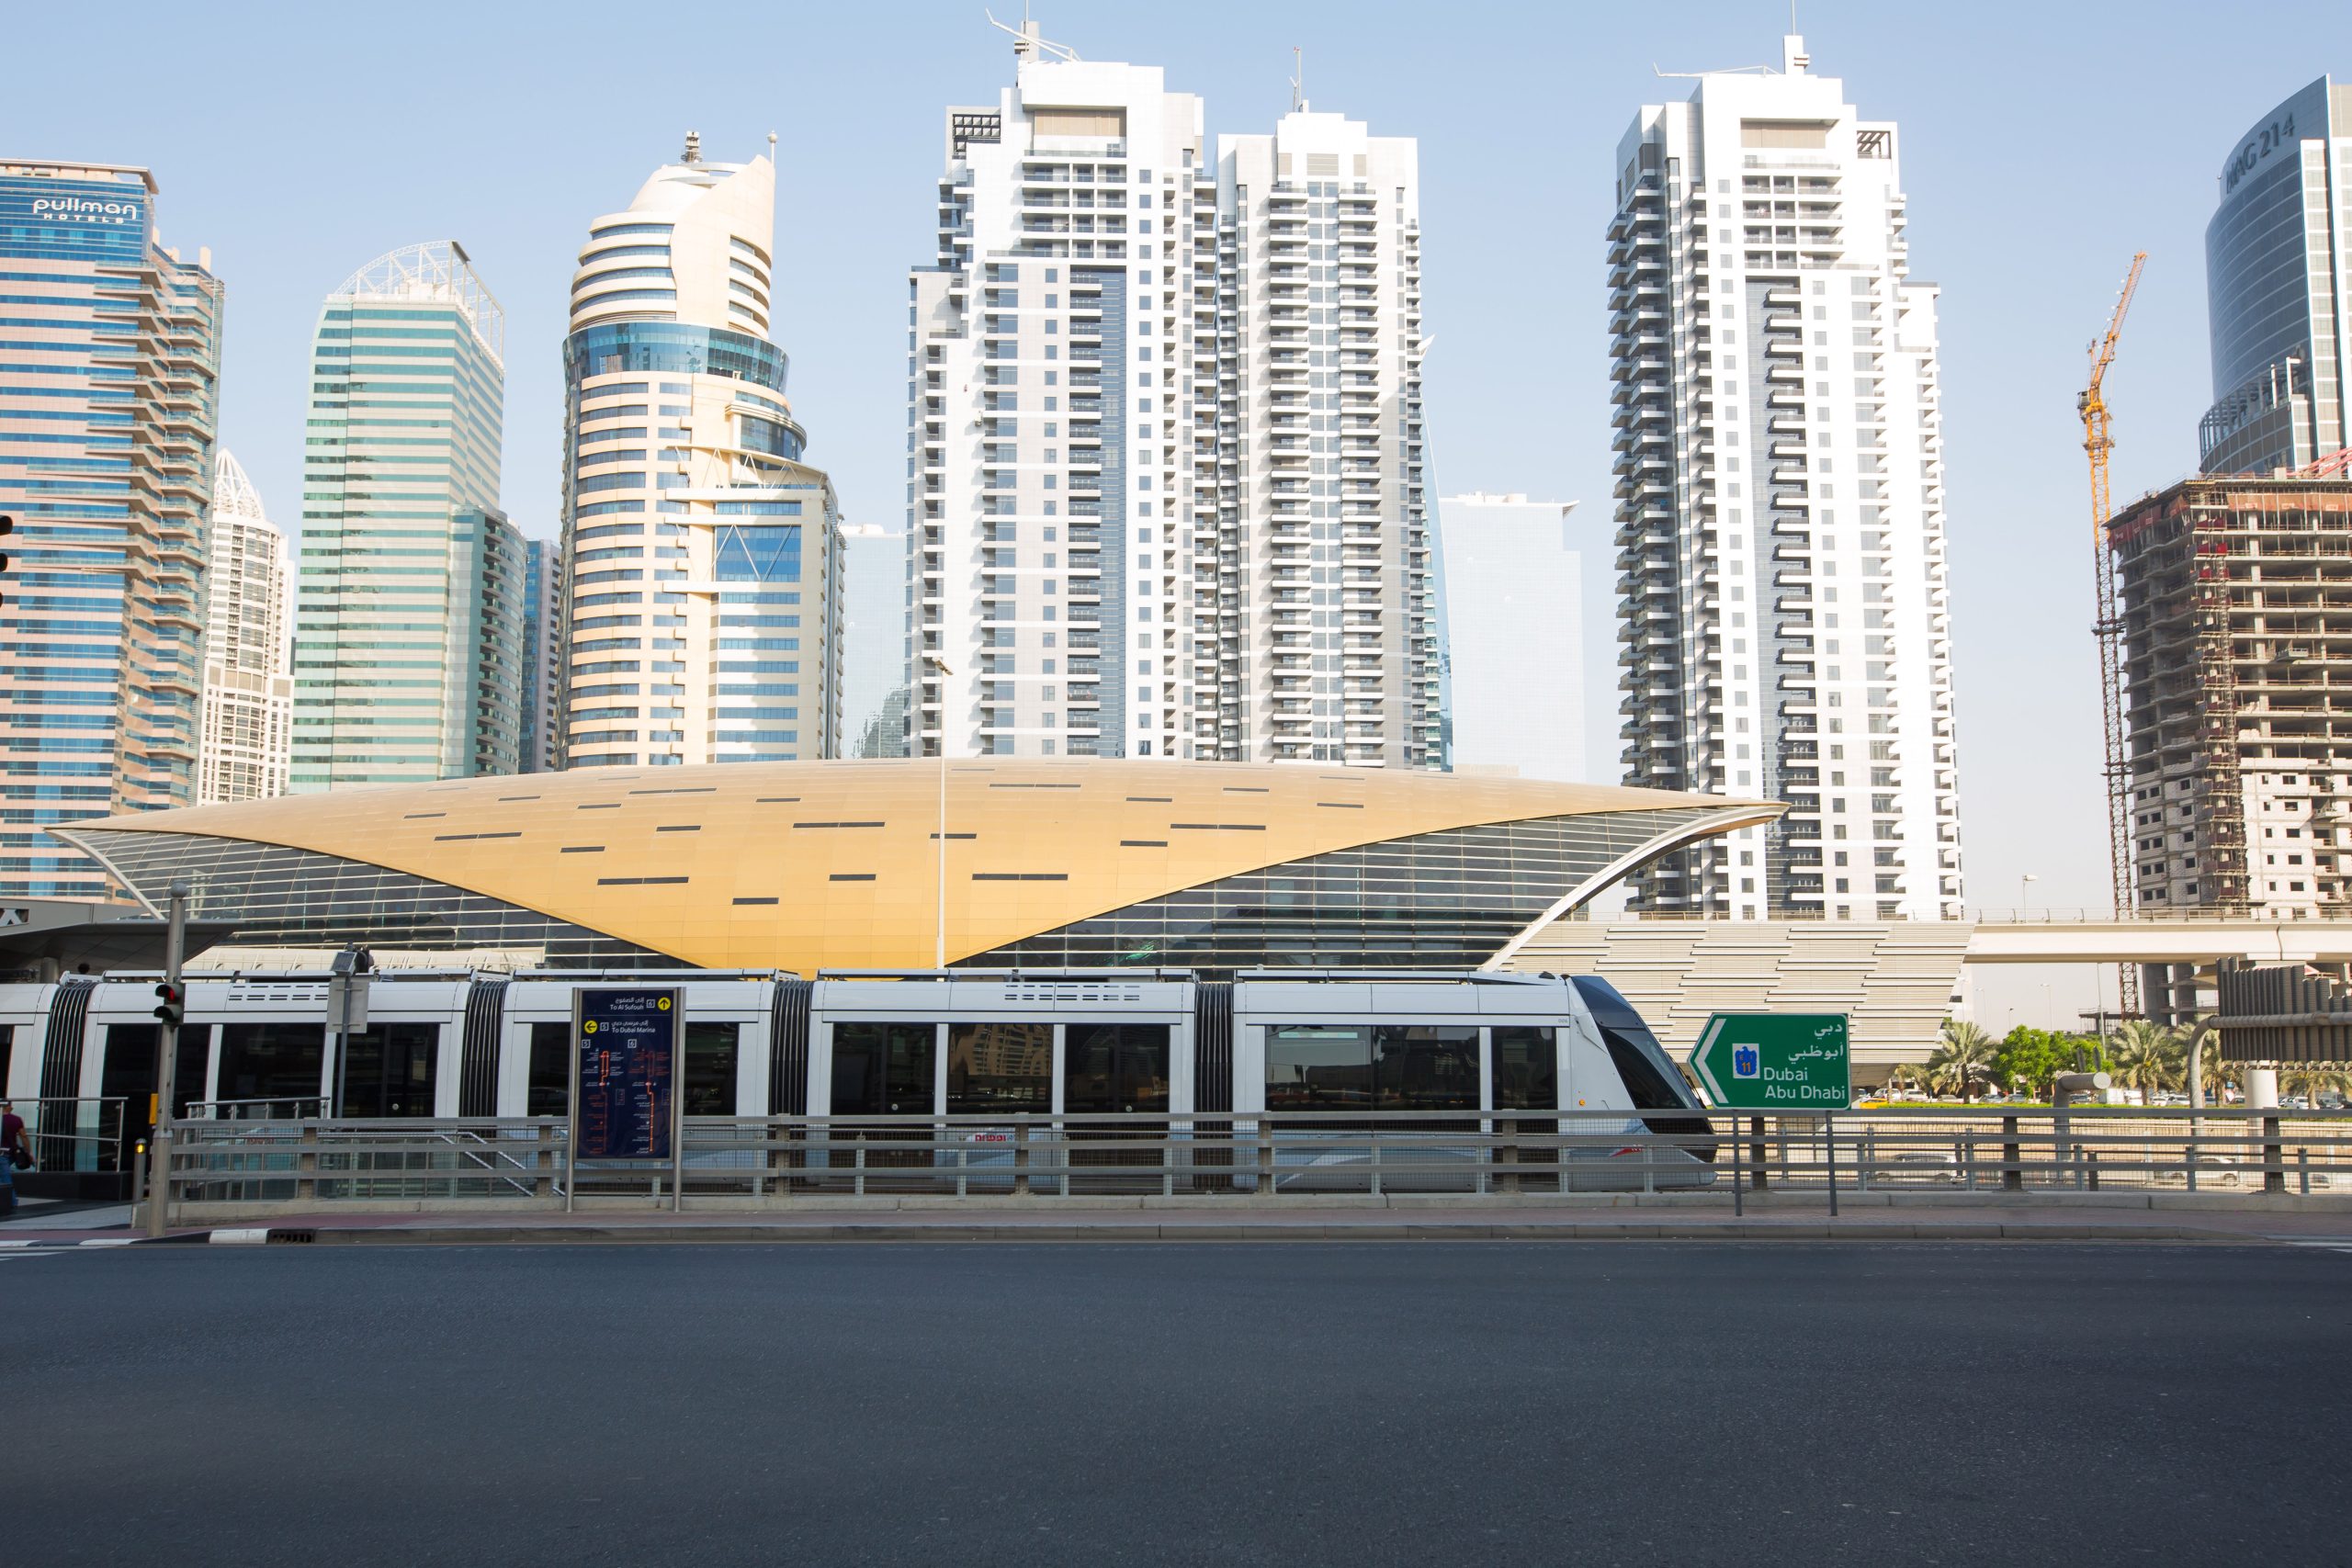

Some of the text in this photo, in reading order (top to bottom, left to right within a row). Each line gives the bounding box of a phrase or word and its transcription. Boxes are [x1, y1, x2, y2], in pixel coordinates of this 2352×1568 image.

[2259, 112, 2295, 158] 214
[33, 197, 137, 220] pullman
[44, 212, 124, 224] HOTELS
[1815, 1023, 1843, 1040] دبي
[1742, 1062, 1751, 1073] 11
[1764, 1067, 1808, 1081] Dubai
[1765, 1085, 1846, 1100] Abu Dhabi
